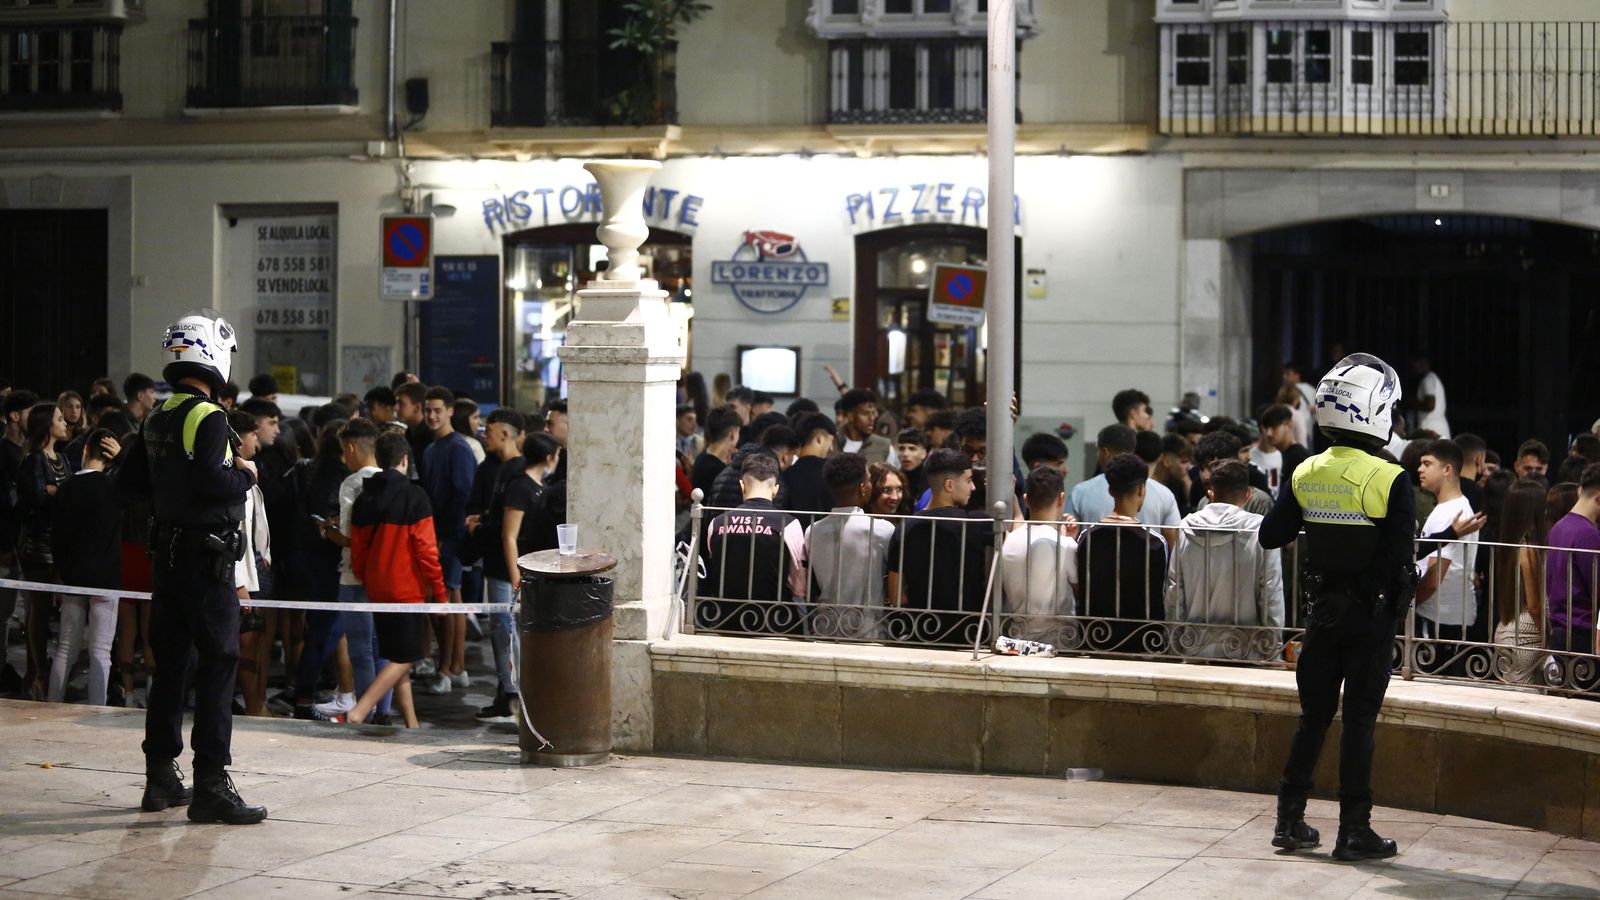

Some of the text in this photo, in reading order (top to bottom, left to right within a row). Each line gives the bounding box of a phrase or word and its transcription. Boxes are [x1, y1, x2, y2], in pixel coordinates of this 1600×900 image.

[482, 183, 704, 233] RISTORNTE
[258, 225, 330, 241] SE ALQUILA LOCAL
[257, 257, 330, 272] 678 558 581
[719, 266, 820, 281] LORENZO
[257, 278, 330, 293] SE VENDE LOCAL
[257, 309, 330, 324] 678 558 581
[180, 324, 198, 332] LOCAL
[1335, 388, 1353, 399] LOCAL
[1327, 483, 1354, 496] LOCAL
